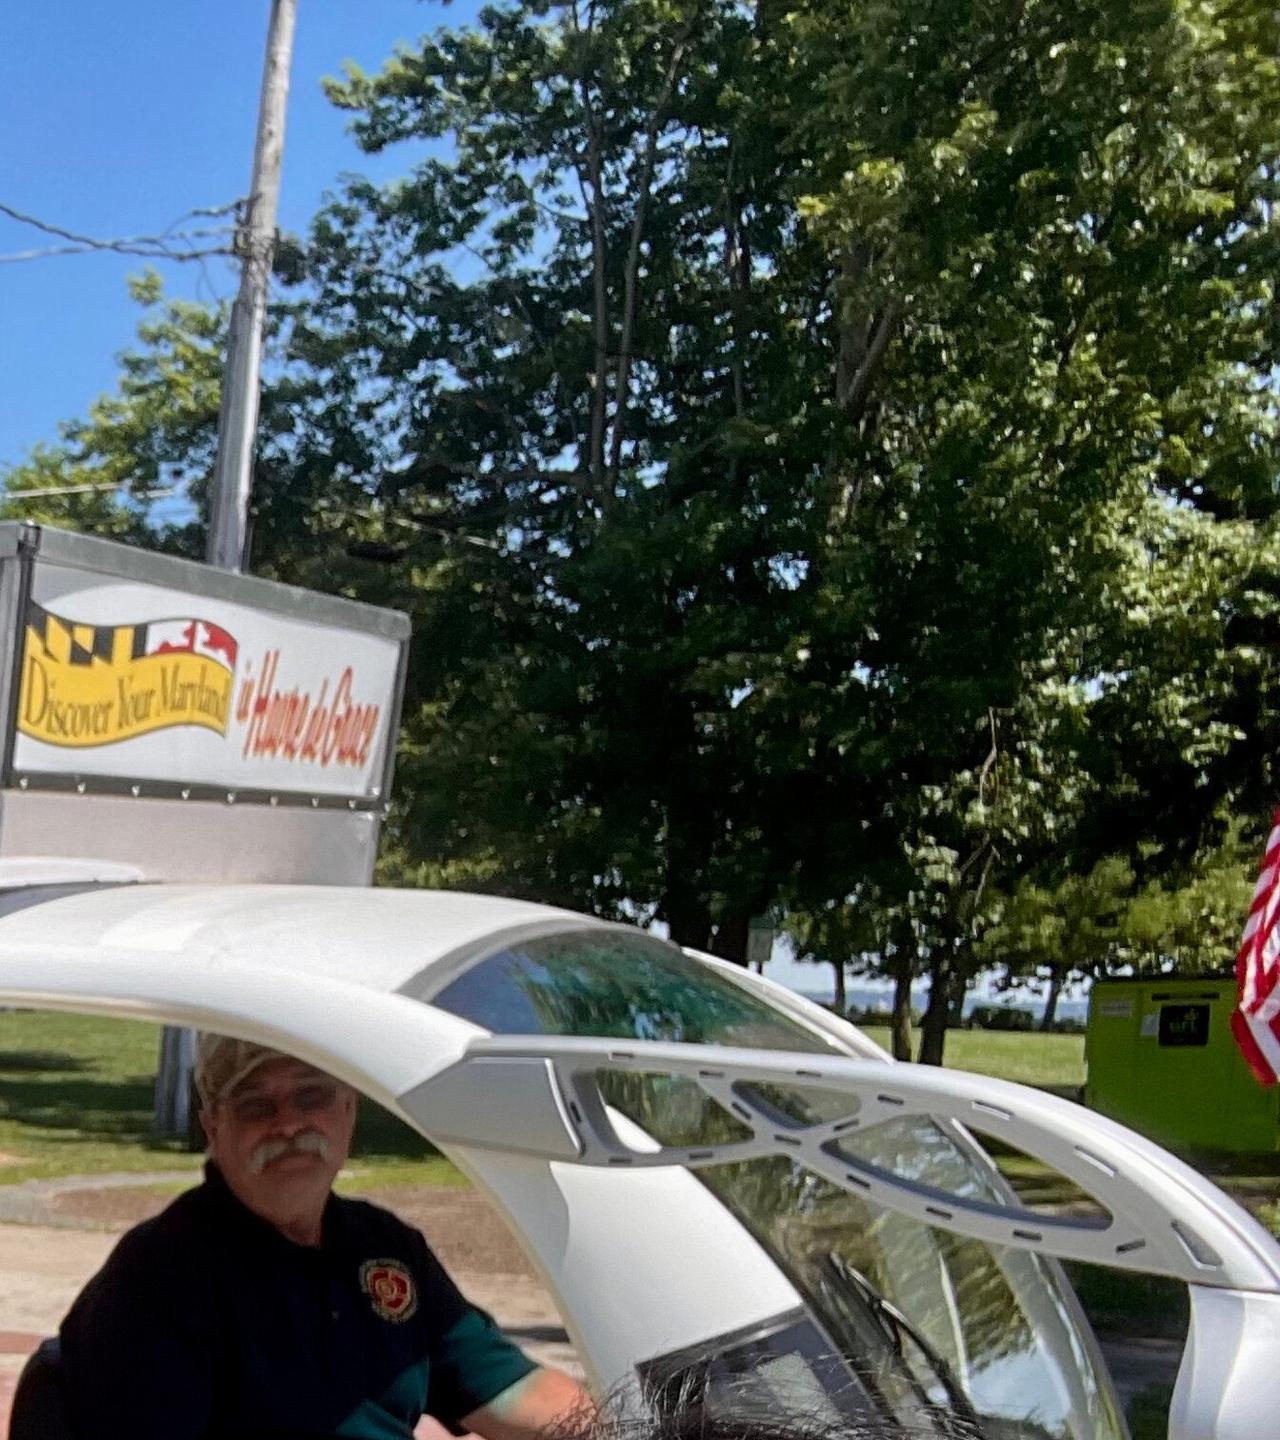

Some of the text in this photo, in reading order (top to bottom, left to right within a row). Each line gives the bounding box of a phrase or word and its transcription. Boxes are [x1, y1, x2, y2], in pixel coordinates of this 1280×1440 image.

[25, 656, 233, 738] Discover Your Maryland
